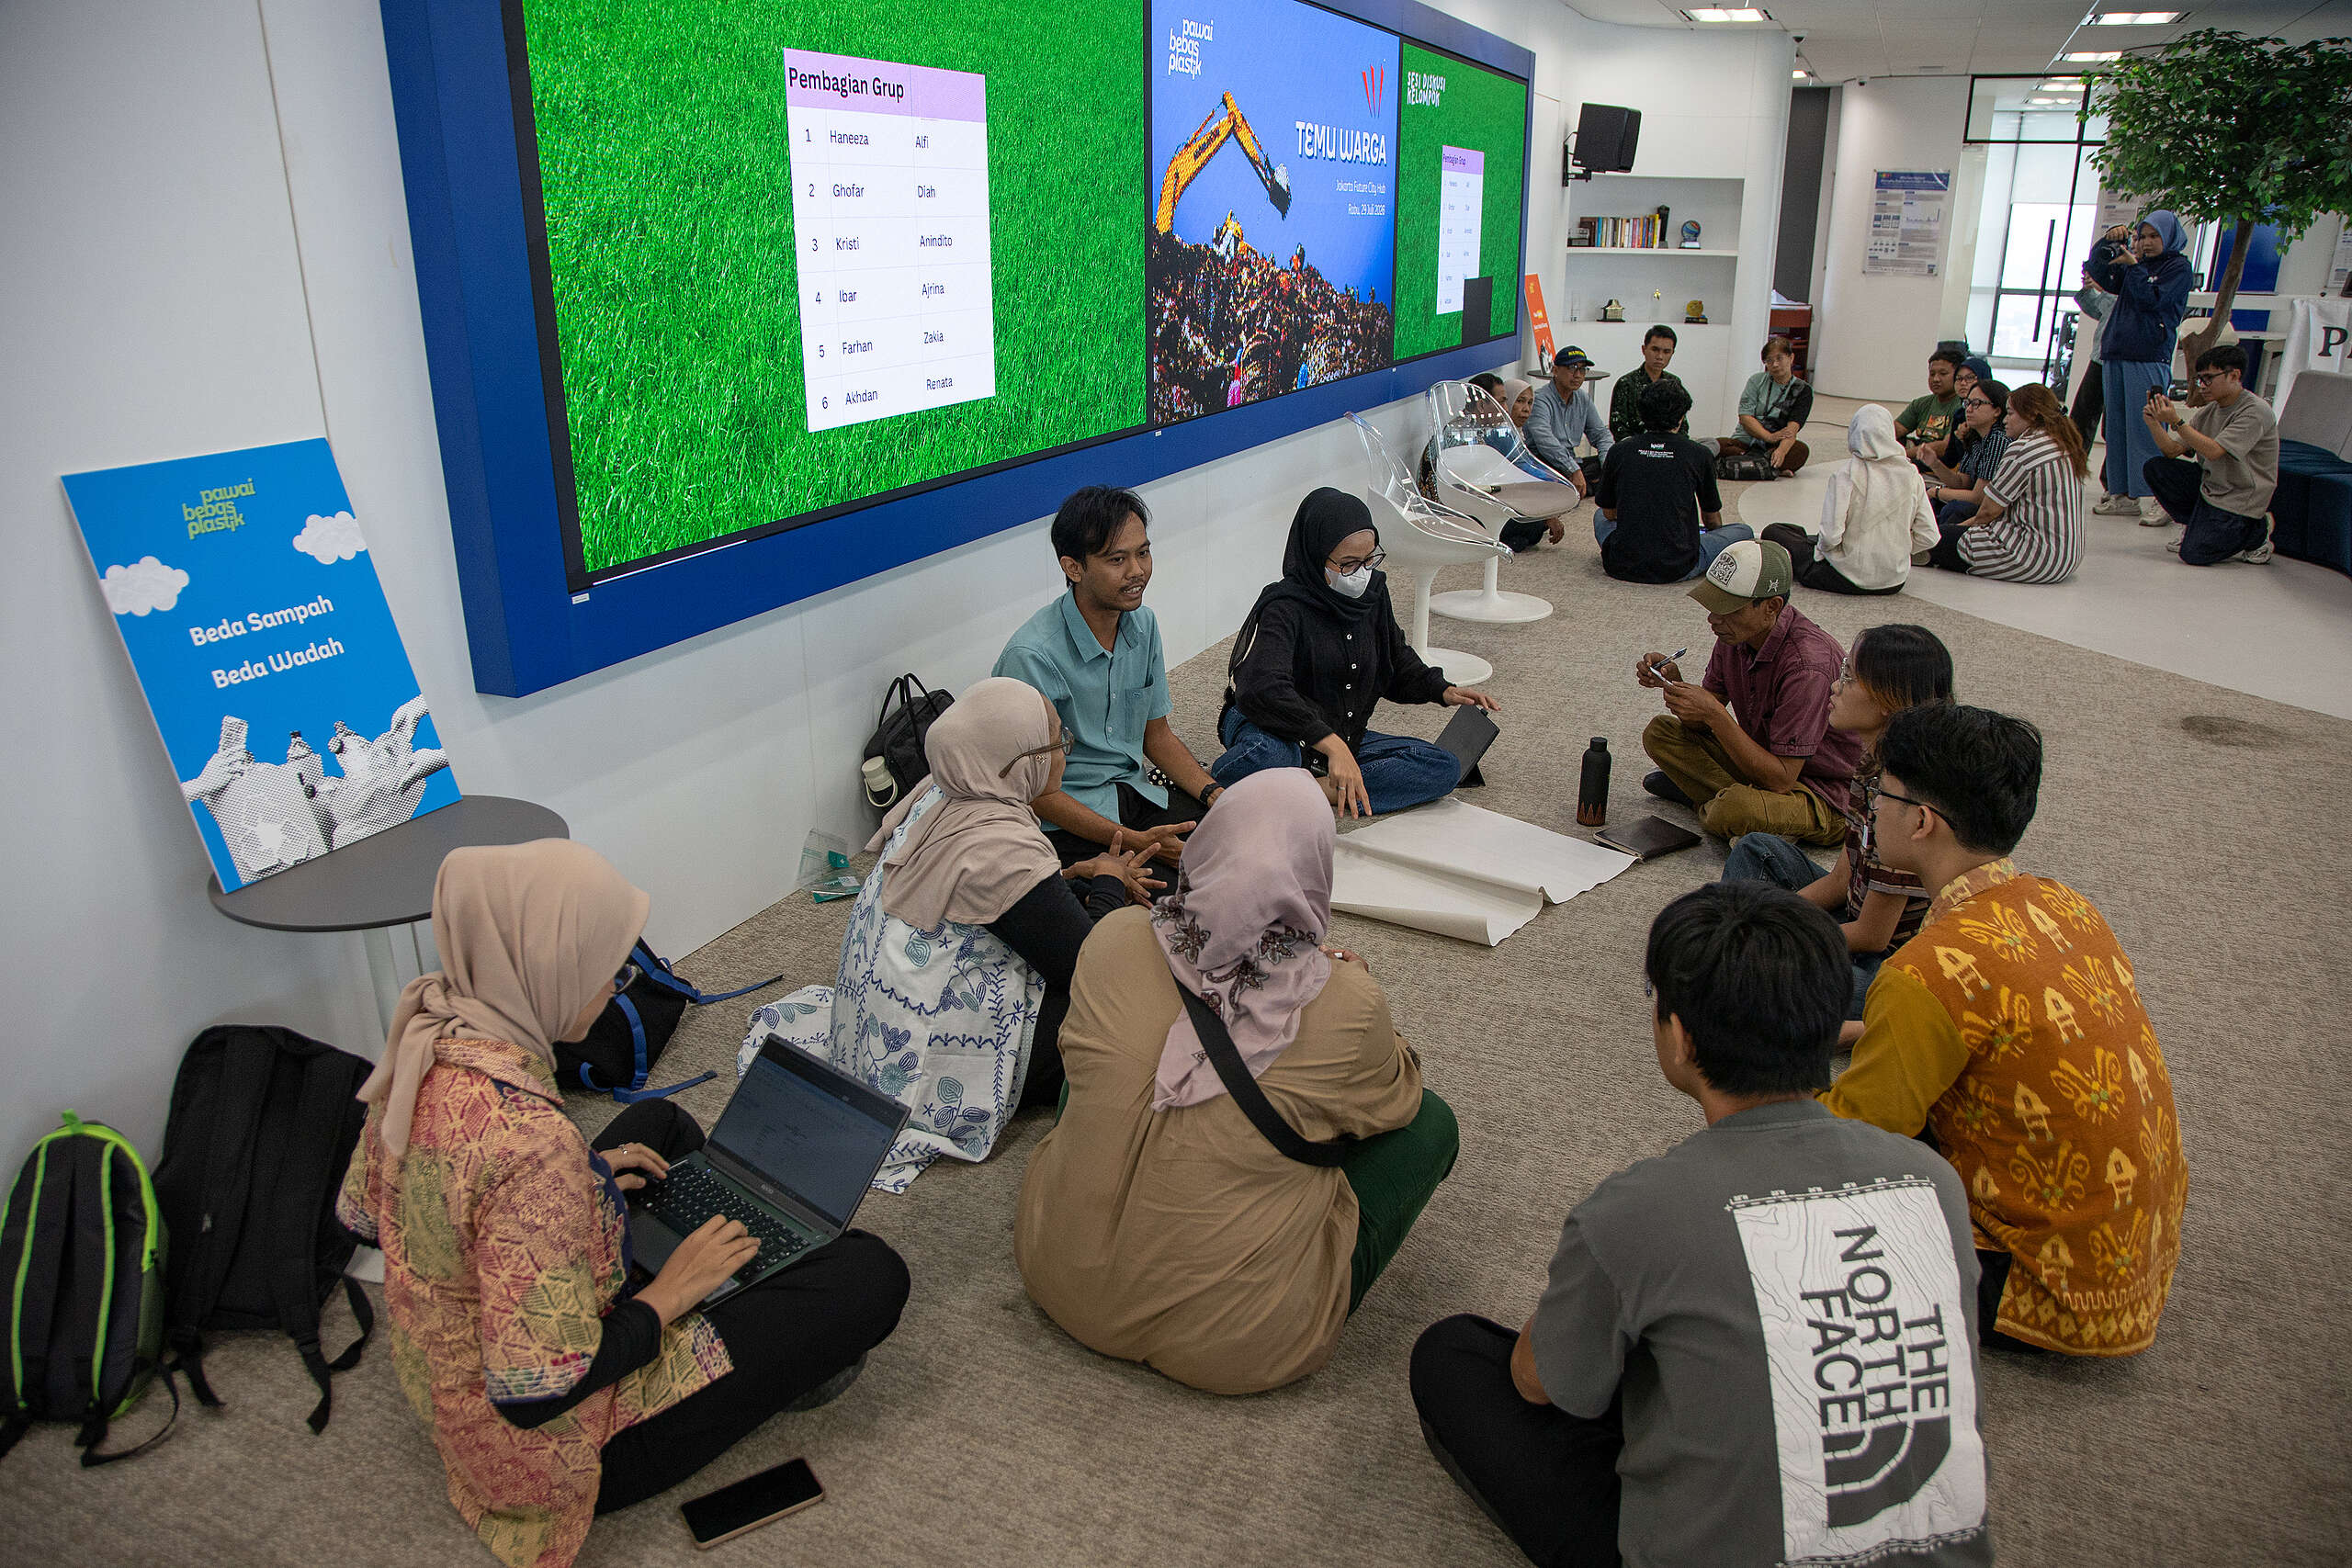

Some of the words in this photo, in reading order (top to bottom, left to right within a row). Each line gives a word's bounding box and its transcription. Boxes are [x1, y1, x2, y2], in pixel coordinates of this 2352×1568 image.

[1170, 28, 1200, 56] bebas
[1182, 18, 1213, 42] pawai
[1169, 52, 1202, 80] plastik
[788, 67, 868, 97] Pembagian
[872, 77, 904, 103] Grup
[1408, 72, 1421, 89] SESI
[1422, 73, 1446, 93] DISKUSI
[1407, 87, 1440, 107] KELOMPOK
[805, 129, 812, 142] 1
[830, 130, 869, 145] Haneeza
[915, 136, 929, 149] Alfi
[1295, 121, 1336, 161] TEMU
[1340, 129, 1386, 166] WARGA
[808, 184, 815, 197] 2
[832, 184, 865, 197] Ghofar
[917, 185, 936, 198] Diah
[812, 239, 819, 252] 3
[836, 236, 860, 251] Kristi
[920, 235, 953, 247] Anindito
[815, 292, 821, 304] 4
[839, 289, 857, 303] Ibar
[922, 283, 944, 299] Ajrina
[819, 345, 825, 358] 5
[842, 340, 873, 355] Farhan
[923, 331, 944, 344] Zakia
[2317, 325, 2352, 359] P
[821, 397, 828, 410] 6
[845, 389, 878, 405] Akhdan
[926, 376, 953, 390] Renata
[199, 478, 255, 505] pawai
[182, 501, 237, 521] bebas
[187, 513, 245, 540] plastik
[189, 618, 248, 647] Beda
[247, 594, 334, 632] Sampah
[211, 660, 269, 689] Beda
[267, 637, 345, 672] Wadah
[1833, 1225, 1908, 1420] NORTH
[1800, 1288, 1867, 1427] FACE
[1904, 1303, 1950, 1412] THE
